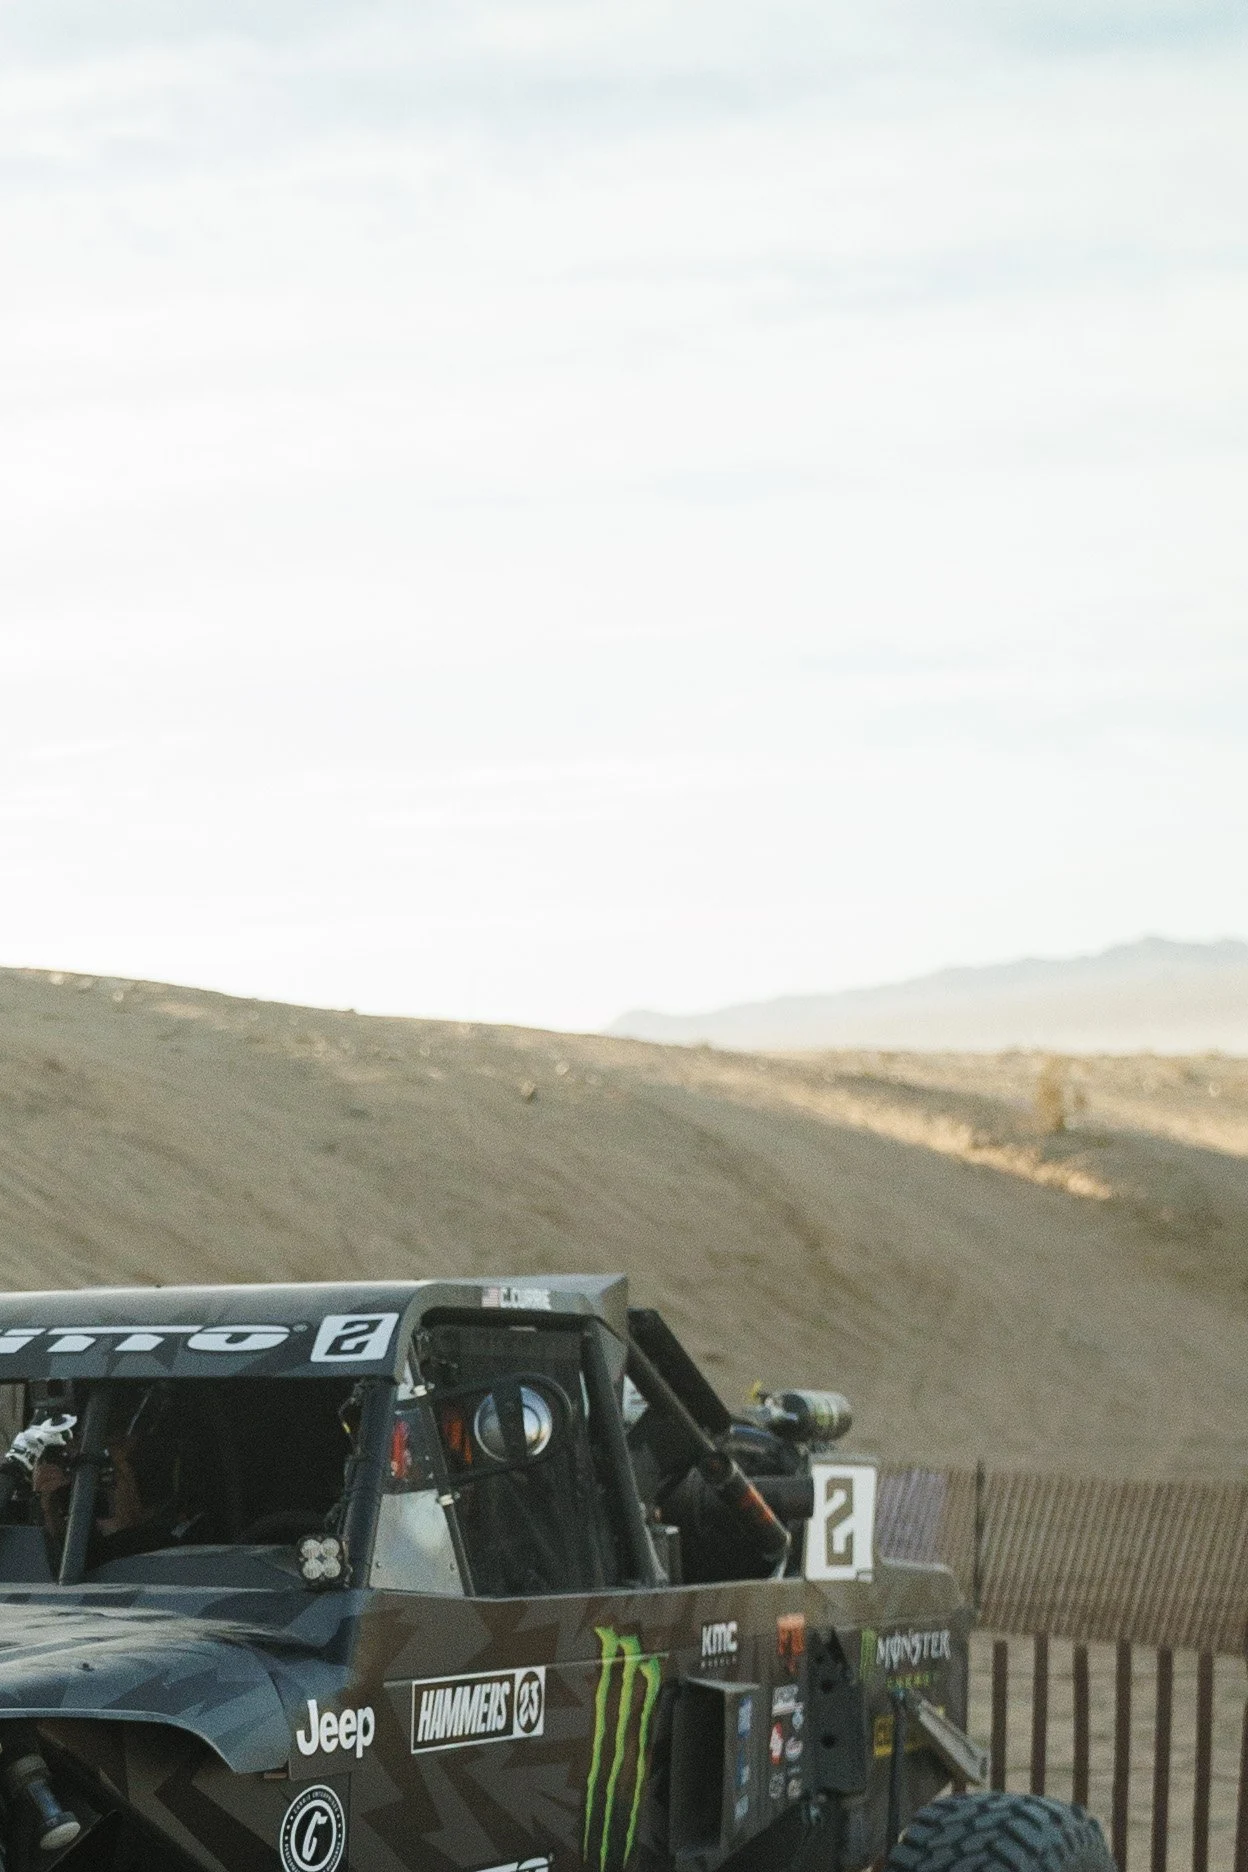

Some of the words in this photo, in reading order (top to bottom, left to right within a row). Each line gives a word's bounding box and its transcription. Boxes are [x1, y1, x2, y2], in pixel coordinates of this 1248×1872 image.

[324, 1318, 384, 1356] 2
[825, 1478, 853, 1566] 2
[701, 1621, 738, 1657] KMC
[876, 1628, 951, 1670] MONSTER
[296, 1699, 375, 1758] Jeep
[417, 1681, 511, 1742] HAMMERS
[519, 1681, 540, 1728] 23
